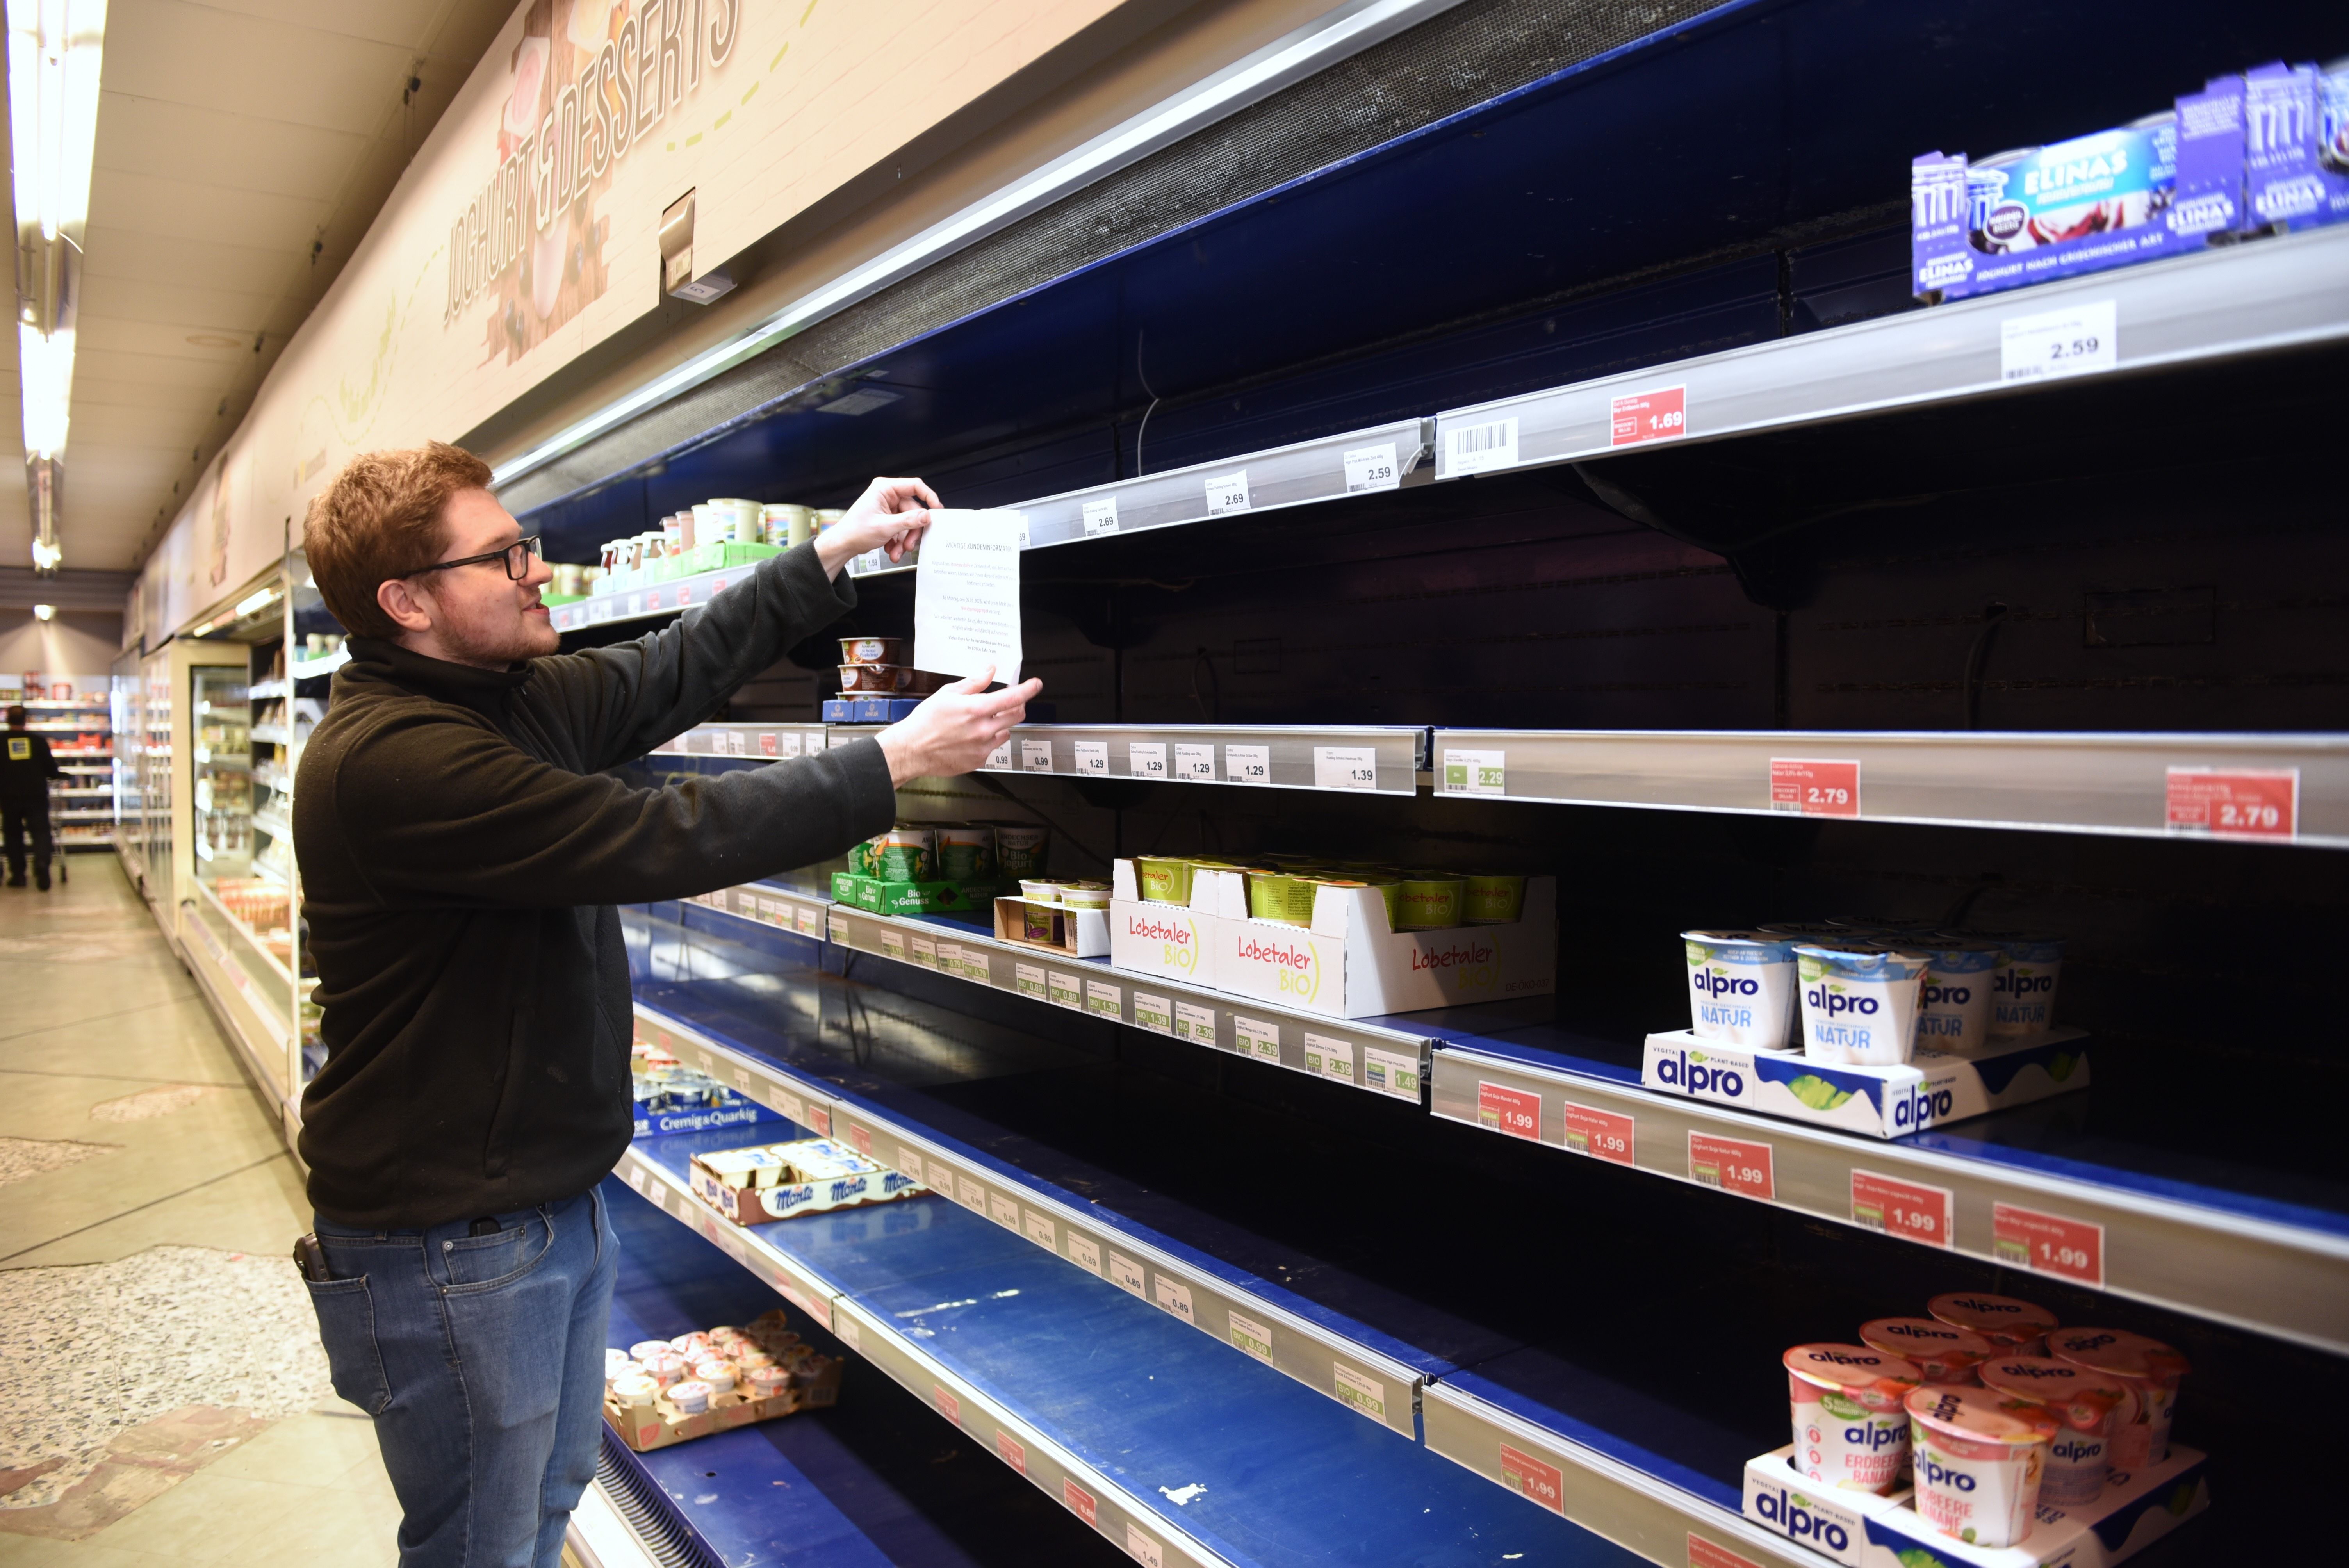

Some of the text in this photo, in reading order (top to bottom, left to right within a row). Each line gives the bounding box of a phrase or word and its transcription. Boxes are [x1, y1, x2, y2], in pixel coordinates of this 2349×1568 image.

[444, 130, 535, 326] JOGHURT
[556, 0, 739, 216] DESSERTS
[2024, 150, 2129, 196] ELINAS
[2255, 182, 2326, 214] ELINAS
[2166, 200, 2234, 229] ELINAS
[1919, 258, 1974, 282] ELINAS
[2051, 337, 2098, 359] 2.59
[1650, 411, 1682, 429] 1.69
[1368, 467, 1390, 480] 2.59
[1225, 494, 1243, 505] 2.69
[1099, 517, 1113, 527] 2.69
[967, 543, 1012, 552] KUNDENINFORMATION
[996, 756, 1008, 764] 0.99
[1035, 757, 1048, 766] 0.99
[1090, 759, 1103, 768] 1.29
[1146, 761, 1162, 771] 1.29
[1193, 763, 1210, 773] 1.29
[1246, 765, 1264, 775] 1.29
[1352, 770, 1372, 780] 1.39
[1479, 771, 1502, 784] 2.29
[1808, 787, 1848, 805] 2.79
[1010, 850, 1028, 859] Bio
[836, 877, 853, 886] ANDECHSER
[839, 884, 850, 893] NATUR
[861, 892, 876, 903] Genuss
[899, 896, 929, 906] Genuss
[907, 889, 921, 898] Bio
[1129, 915, 1191, 944] Lobetaler
[1238, 936, 1310, 970] Lobetaler
[1412, 941, 1493, 971] Lobetaler
[950, 959, 961, 968] 0.79
[975, 969, 986, 978] 0.79
[1030, 982, 1042, 993] 0.89
[1506, 978, 1549, 992] DE-ÖKO-037
[1694, 967, 1759, 999] alpro
[1994, 968, 2052, 999] alpro
[1063, 991, 1077, 1002] 0.89
[1809, 984, 1879, 1017] alpro
[1102, 1001, 1117, 1013] 1.39
[1996, 1005, 2045, 1024] NATUR
[1150, 1013, 1166, 1025] 1.39
[1700, 1005, 1752, 1027] NATUR
[1179, 1022, 1188, 1030] BIO
[1196, 1026, 1213, 1038] 2.39
[1239, 1038, 1249, 1047] BIO
[1816, 1023, 1871, 1049] NATUR
[1258, 1042, 1277, 1056] 2.39
[1308, 1056, 1319, 1065] BIO
[1653, 1047, 1749, 1069] VEGETAL PLANT-BASED
[1330, 1060, 1351, 1074] 2.39
[1657, 1049, 1744, 1097] alpro
[1396, 1073, 1417, 1089] 1.49
[1480, 1091, 1492, 1099] Joghurt
[1482, 1111, 1497, 1119] VEGAN
[1895, 1085, 1953, 1132] alpro
[660, 1114, 703, 1131] Cremig
[710, 1108, 757, 1126] Quarkig
[1505, 1110, 1533, 1129] 1.99
[1568, 1133, 1585, 1142] VEGAN
[1594, 1133, 1625, 1153] 1.99
[1727, 1164, 1763, 1184] 1.99
[830, 1176, 868, 1202] Monte
[775, 1184, 814, 1211] Monte
[1003, 1213, 1016, 1224] 0.89
[1893, 1208, 1935, 1232] 1.99
[1039, 1231, 1052, 1243] 0.89
[1082, 1253, 1096, 1266] 0.89
[1125, 1275, 1141, 1289] 0.89
[1172, 1298, 1189, 1313] 0.89
[1953, 1298, 2022, 1314] alpro
[1886, 1324, 1959, 1340] alpro
[1249, 1339, 1267, 1355] 0.99
[2063, 1333, 2117, 1352] alpro
[1808, 1351, 1882, 1367] alpro
[2001, 1363, 2076, 1380] alpro
[1338, 1384, 1379, 1411] BIO 0.99
[1823, 1398, 1834, 1411] 5
[1845, 1421, 1908, 1452] alpro
[2052, 1441, 2102, 1463] alpro
[1913, 1447, 1977, 1492] alpro
[1528, 1477, 1555, 1499] 1.99
[1752, 1477, 1855, 1527] VEGETAL PLANT-BASED
[1756, 1489, 1849, 1552] alpro
[1143, 1551, 1158, 1567] 1.49
